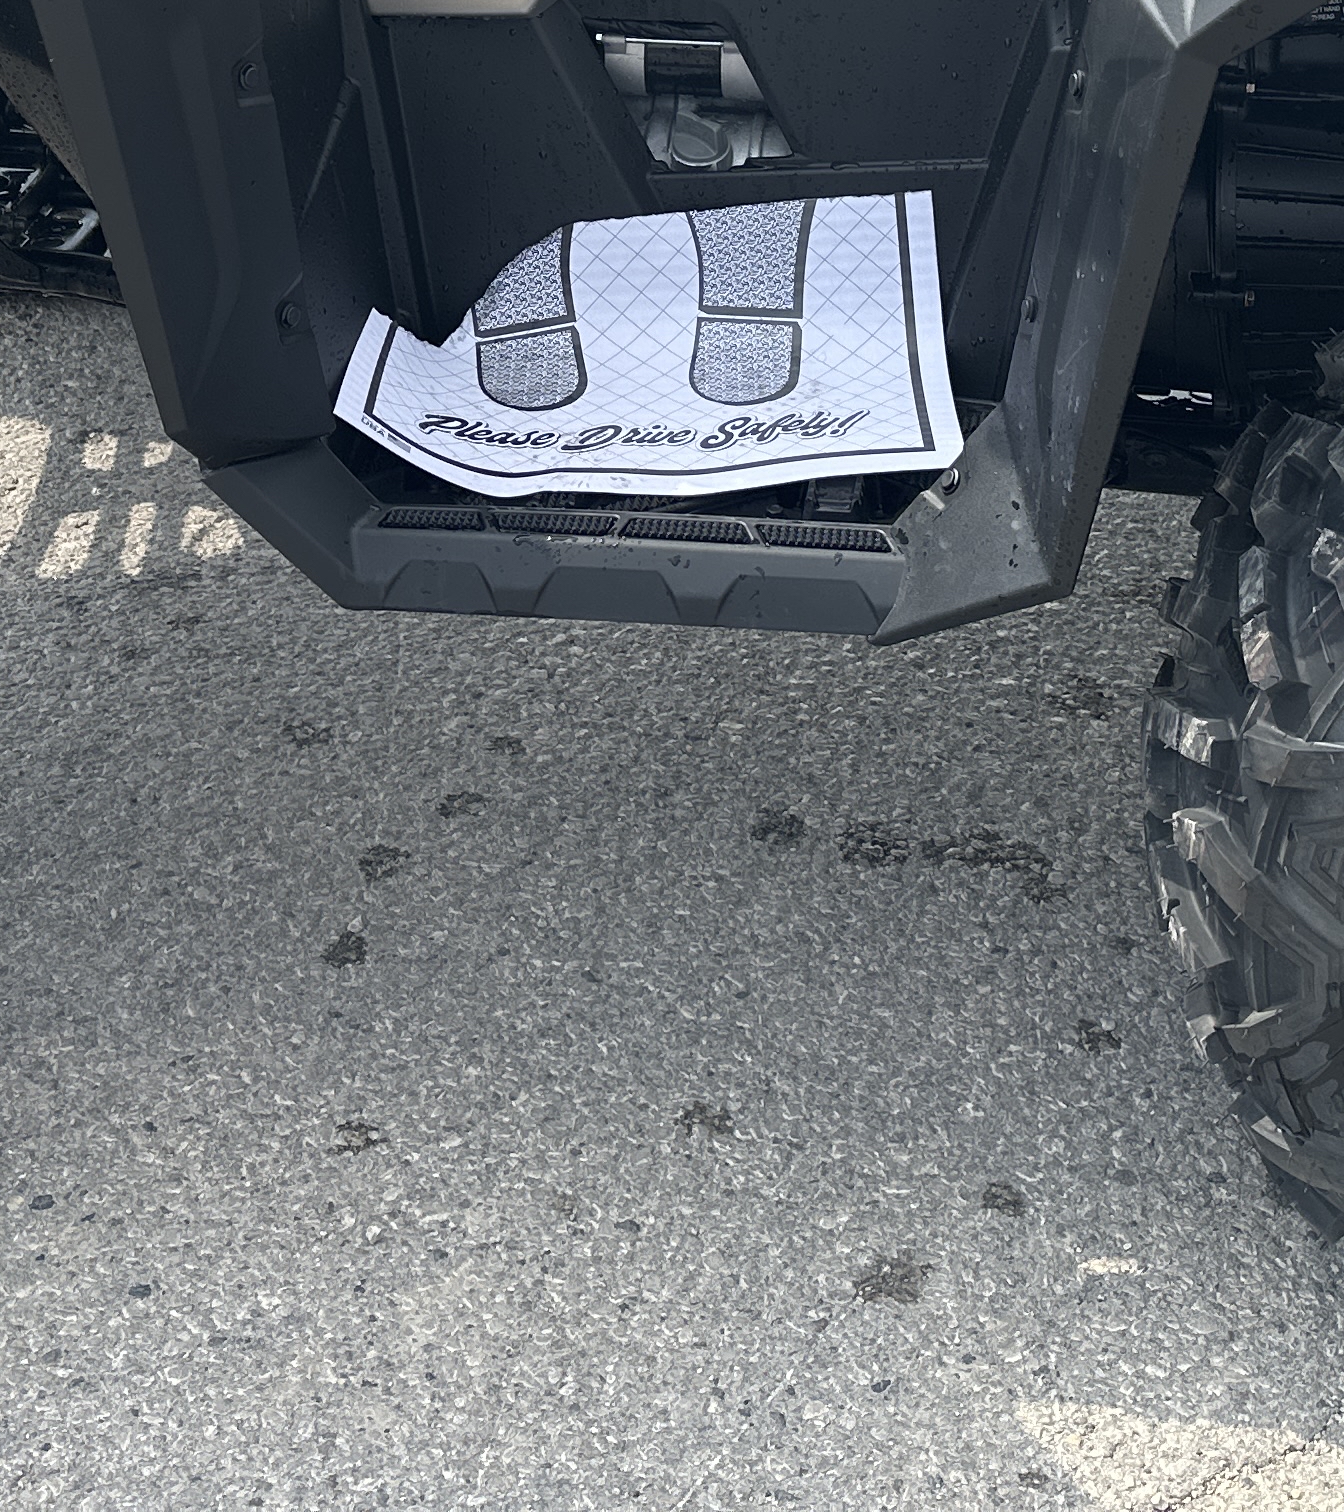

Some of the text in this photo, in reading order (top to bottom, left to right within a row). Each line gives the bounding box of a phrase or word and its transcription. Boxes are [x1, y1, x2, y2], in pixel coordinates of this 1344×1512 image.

[419, 406, 872, 454] Please Drive Safely!
